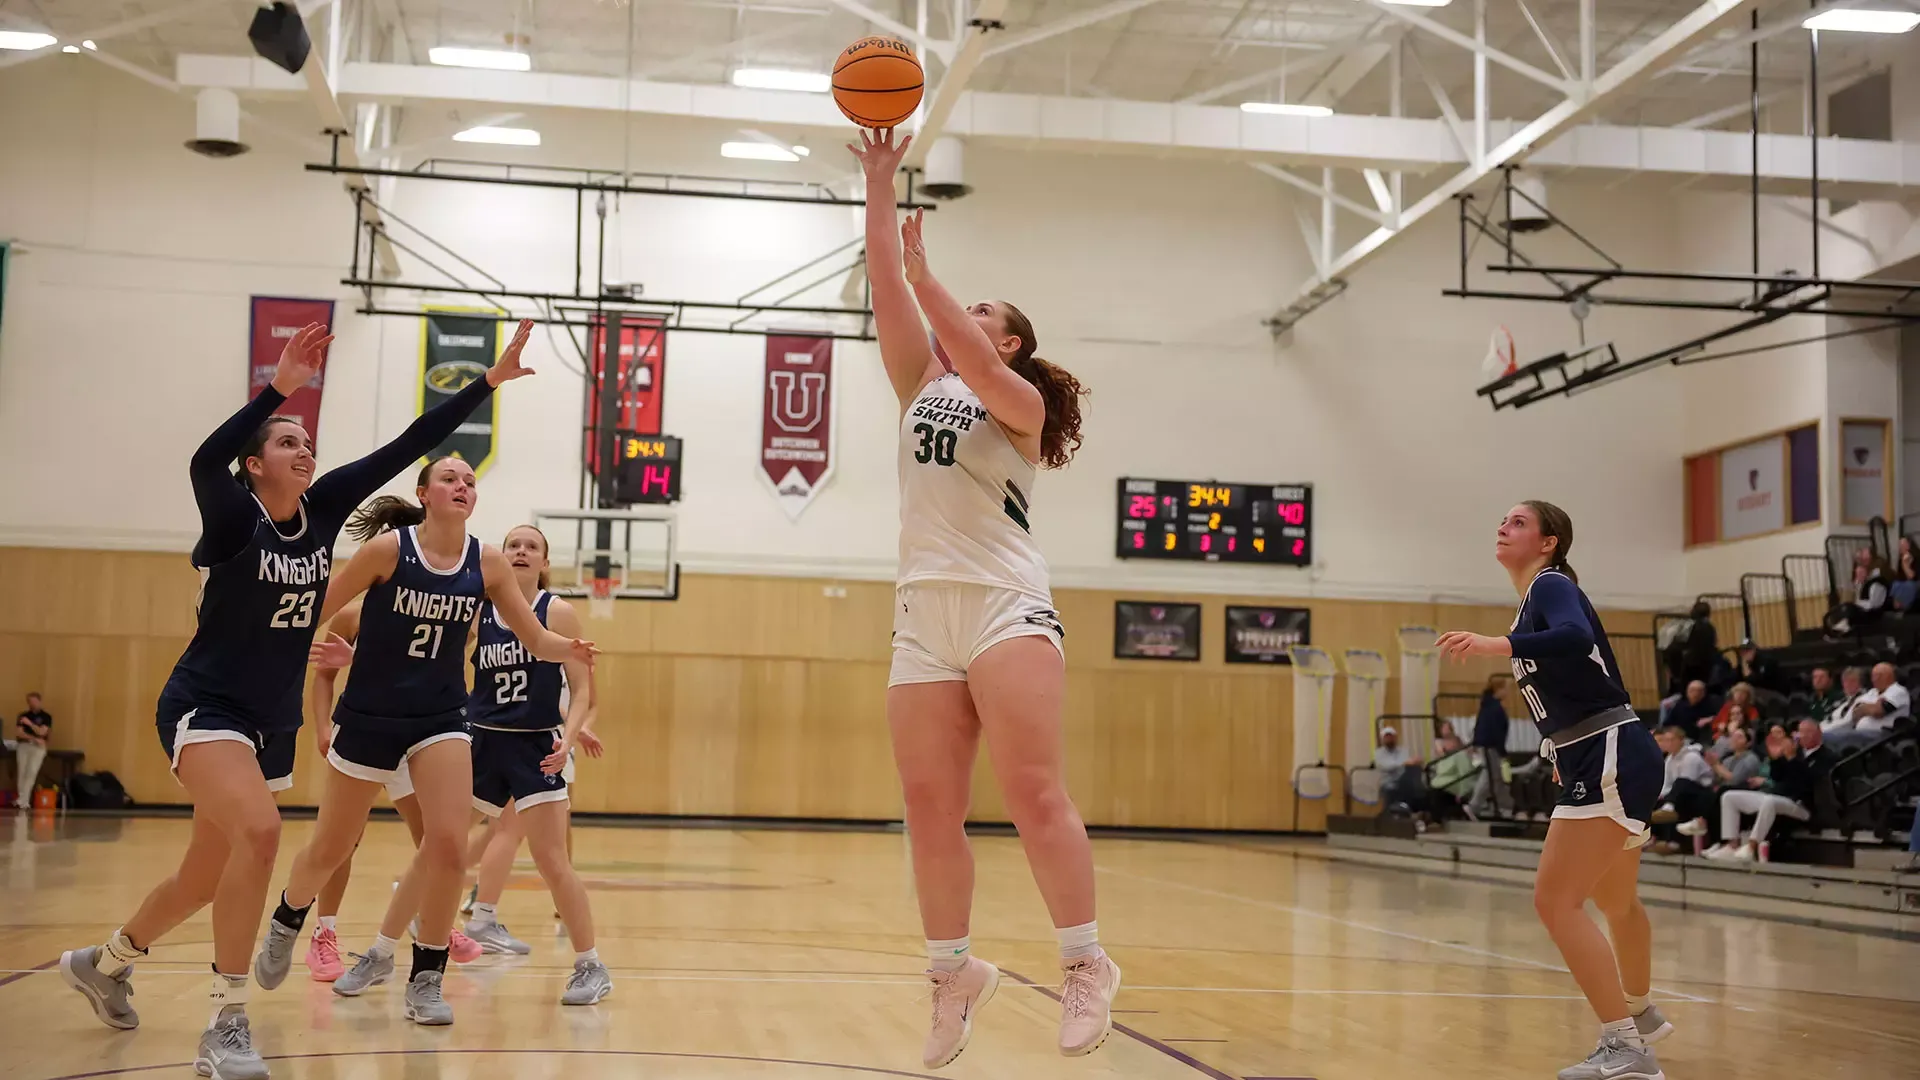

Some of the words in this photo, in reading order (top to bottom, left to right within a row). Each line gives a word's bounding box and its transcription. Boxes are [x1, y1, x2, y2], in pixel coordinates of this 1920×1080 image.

[769, 371, 826, 432] U
[915, 395, 988, 422] WILLIAM
[912, 406, 974, 432] SMITH
[626, 439, 666, 459] 34.4
[912, 422, 958, 467] 30
[641, 465, 671, 496] 14
[1188, 484, 1231, 507] 34.4
[1128, 495, 1157, 519] 25
[1277, 502, 1305, 525] 40
[258, 546, 329, 585] KNIGHTS
[270, 590, 317, 628] 23
[393, 585, 476, 623] KNIGHTS
[407, 624, 443, 659] 21
[480, 640, 532, 669] KNIGH
[494, 670, 528, 704] 22
[1520, 684, 1547, 722] 10
